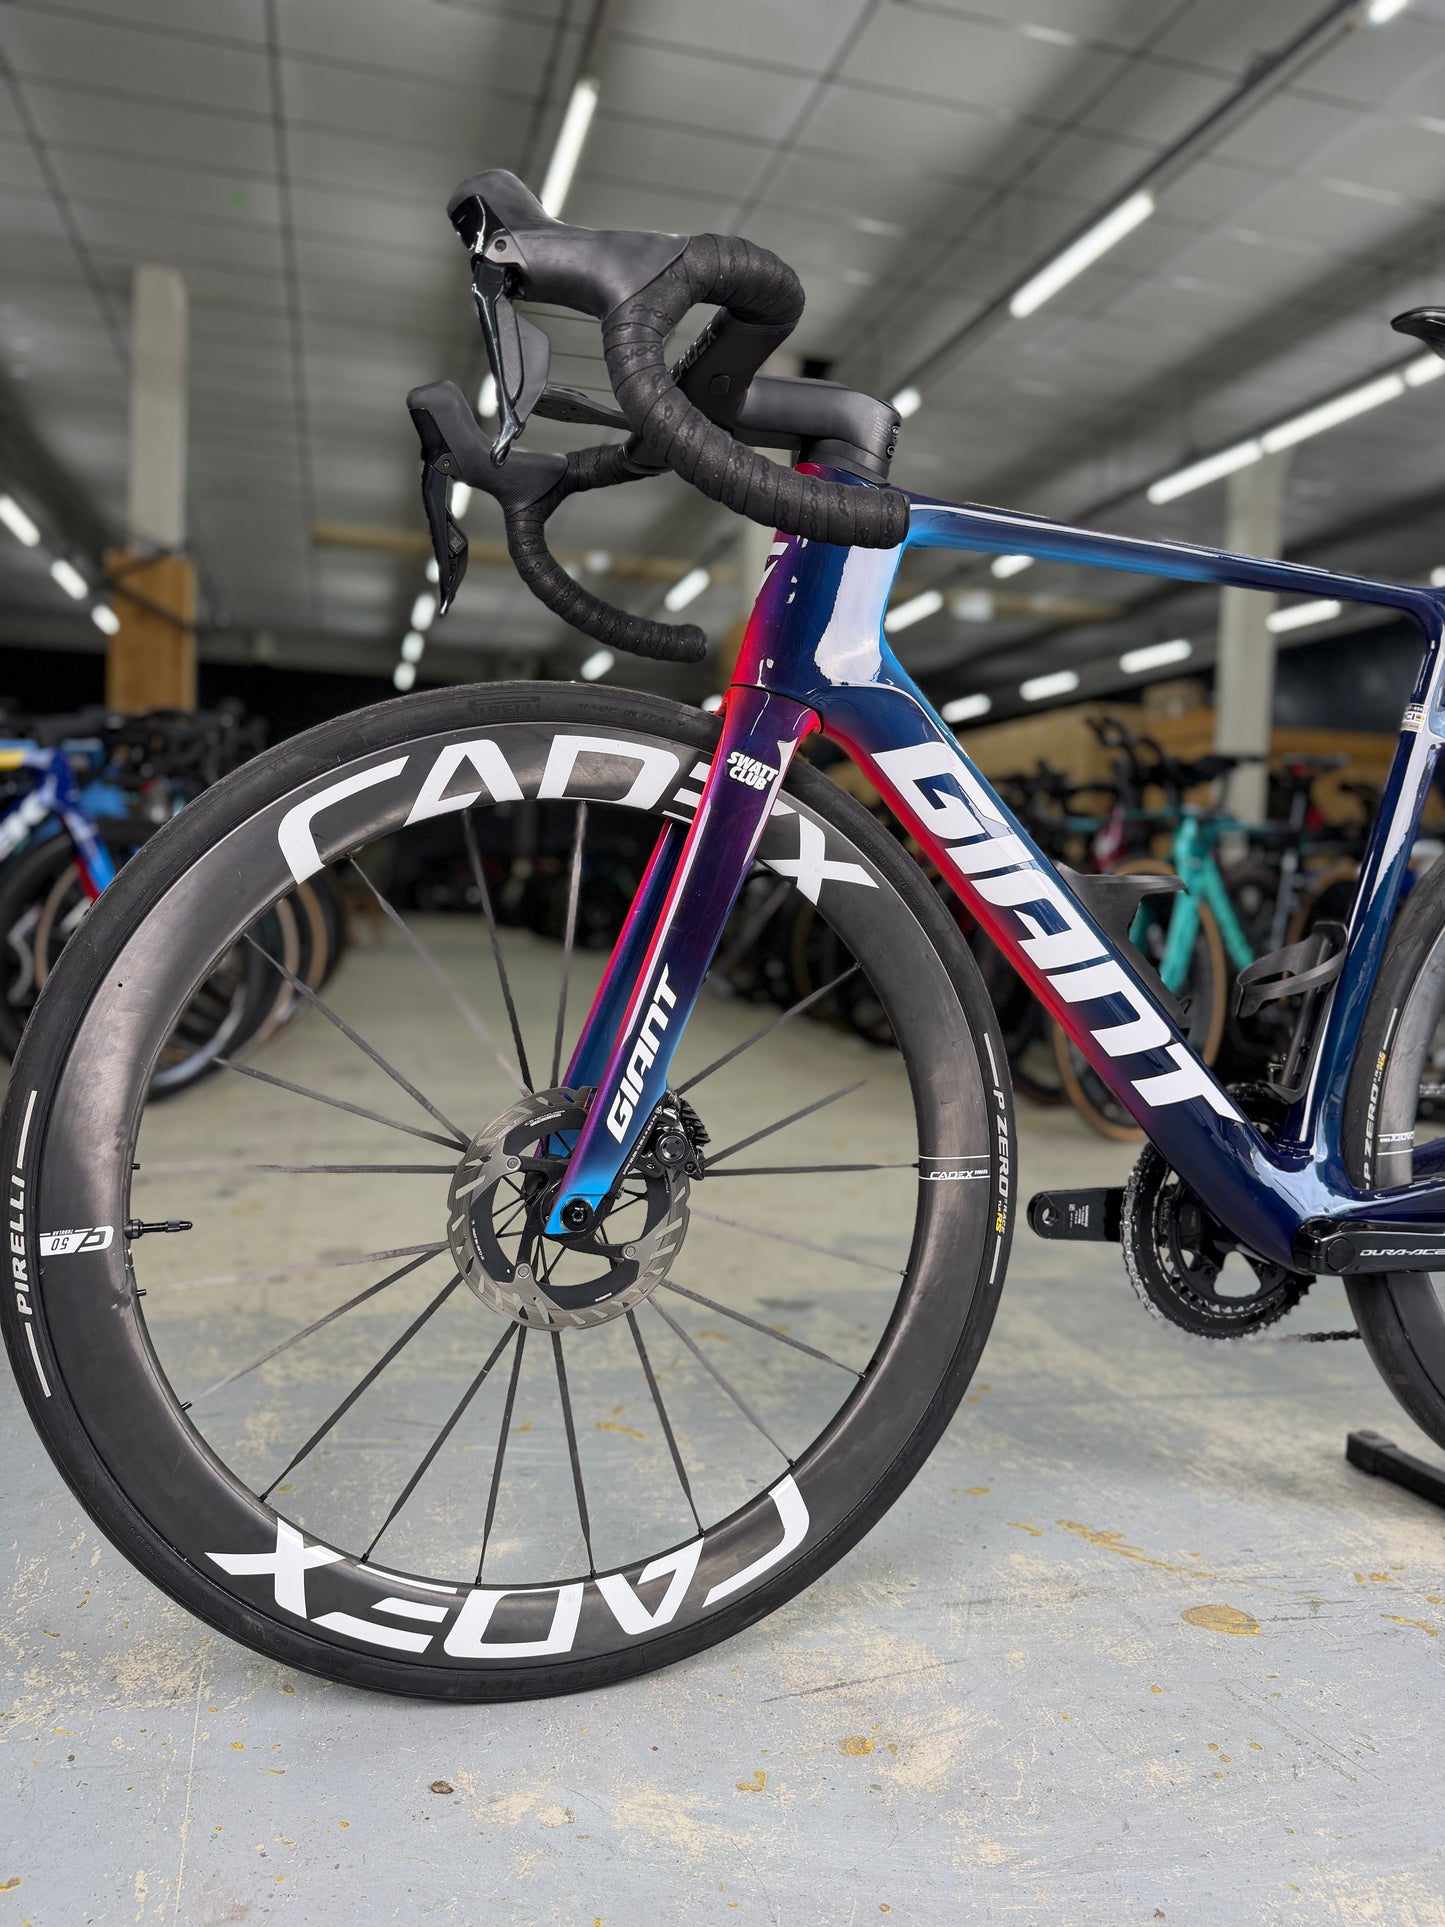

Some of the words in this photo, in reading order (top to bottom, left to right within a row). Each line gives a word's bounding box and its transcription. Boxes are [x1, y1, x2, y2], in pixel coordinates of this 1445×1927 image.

[727, 751, 779, 782] SWATT
[729, 765, 767, 791] CLUB
[871, 742, 1244, 1123] GIANT
[606, 962, 677, 1143] GIANT
[993, 1089, 1005, 1110] P
[1365, 1082, 1379, 1158] ZERO
[997, 1115, 1009, 1198] ZERO
[930, 1170, 974, 1179] CADEX
[995, 1212, 1003, 1233] RS
[10, 1175, 33, 1315] PIRELLI
[51, 1237, 69, 1250] 50
[1360, 1248, 1445, 1257] DURA-ACE
[205, 1474, 810, 1659] CADEX
